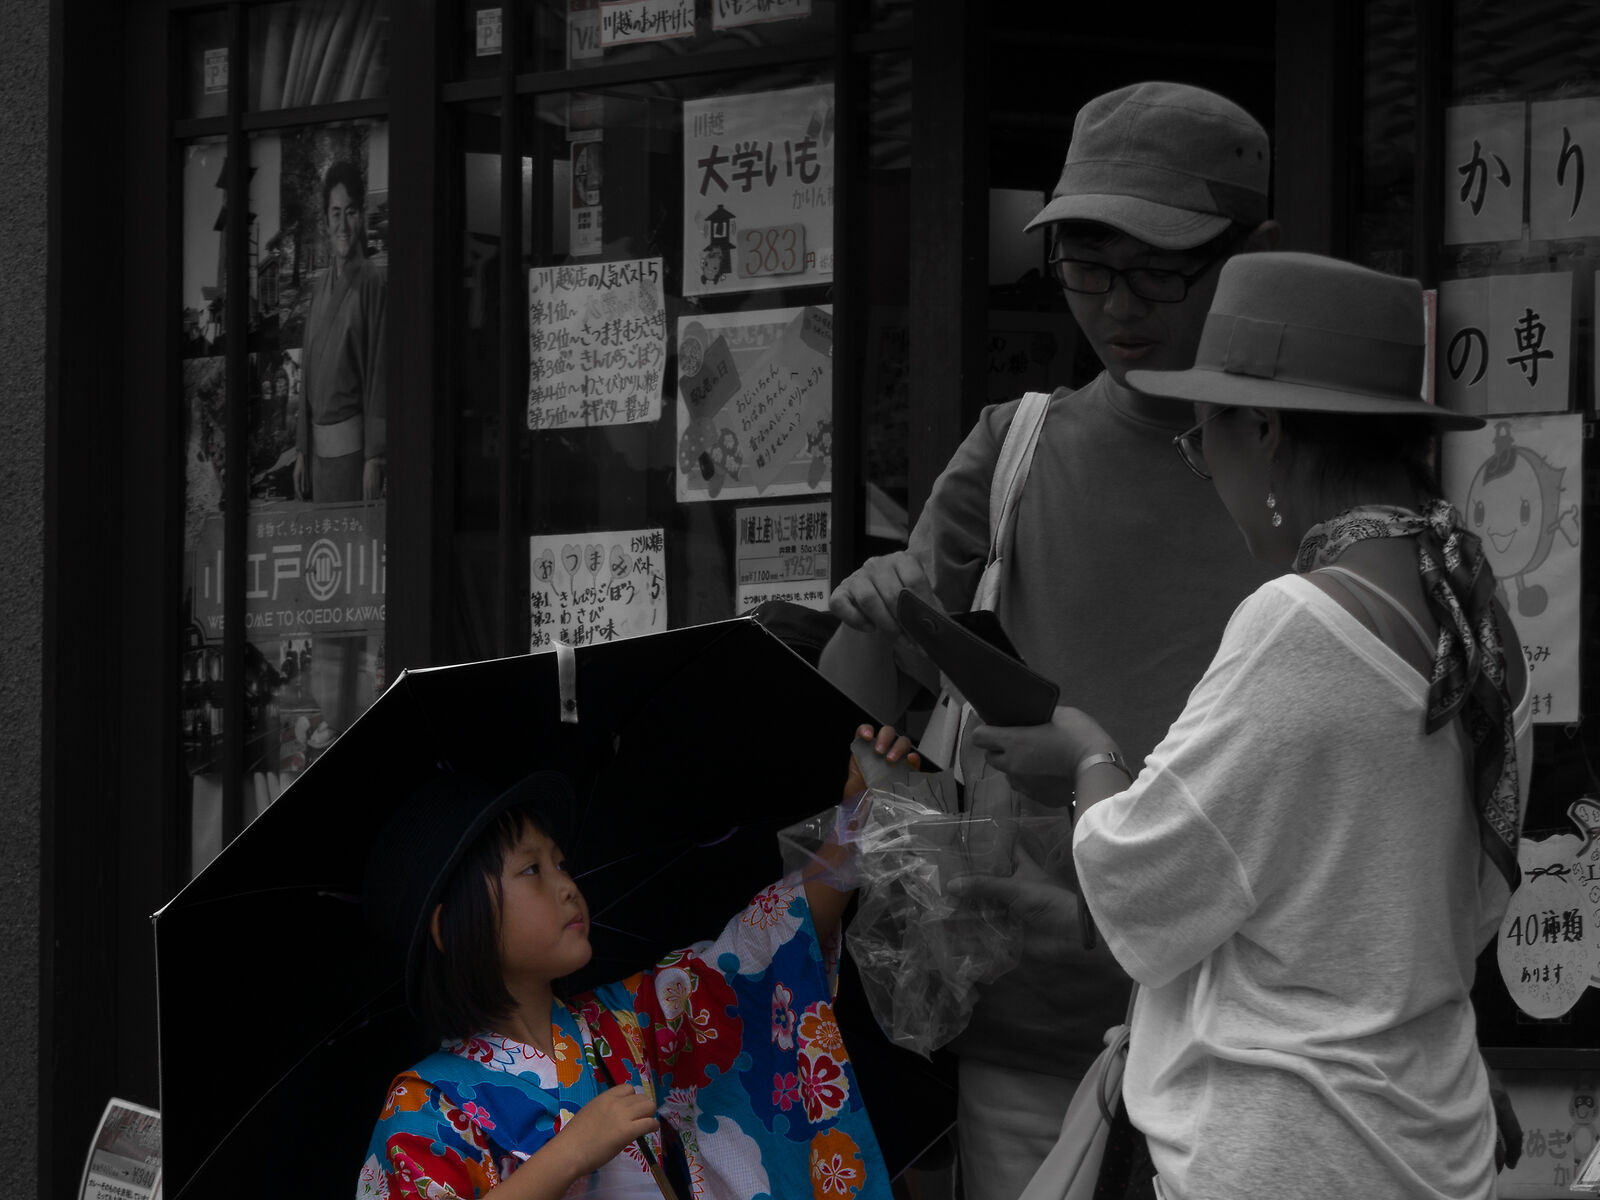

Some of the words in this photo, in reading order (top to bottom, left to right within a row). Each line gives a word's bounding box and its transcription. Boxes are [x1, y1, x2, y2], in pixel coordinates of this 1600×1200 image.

[693, 111, 725, 138] 川越
[697, 135, 822, 197] 大学いも
[276, 609, 295, 627] TO
[296, 605, 343, 626] KOEDO
[1507, 908, 1584, 947] 40種類
[1521, 963, 1564, 984] あります
